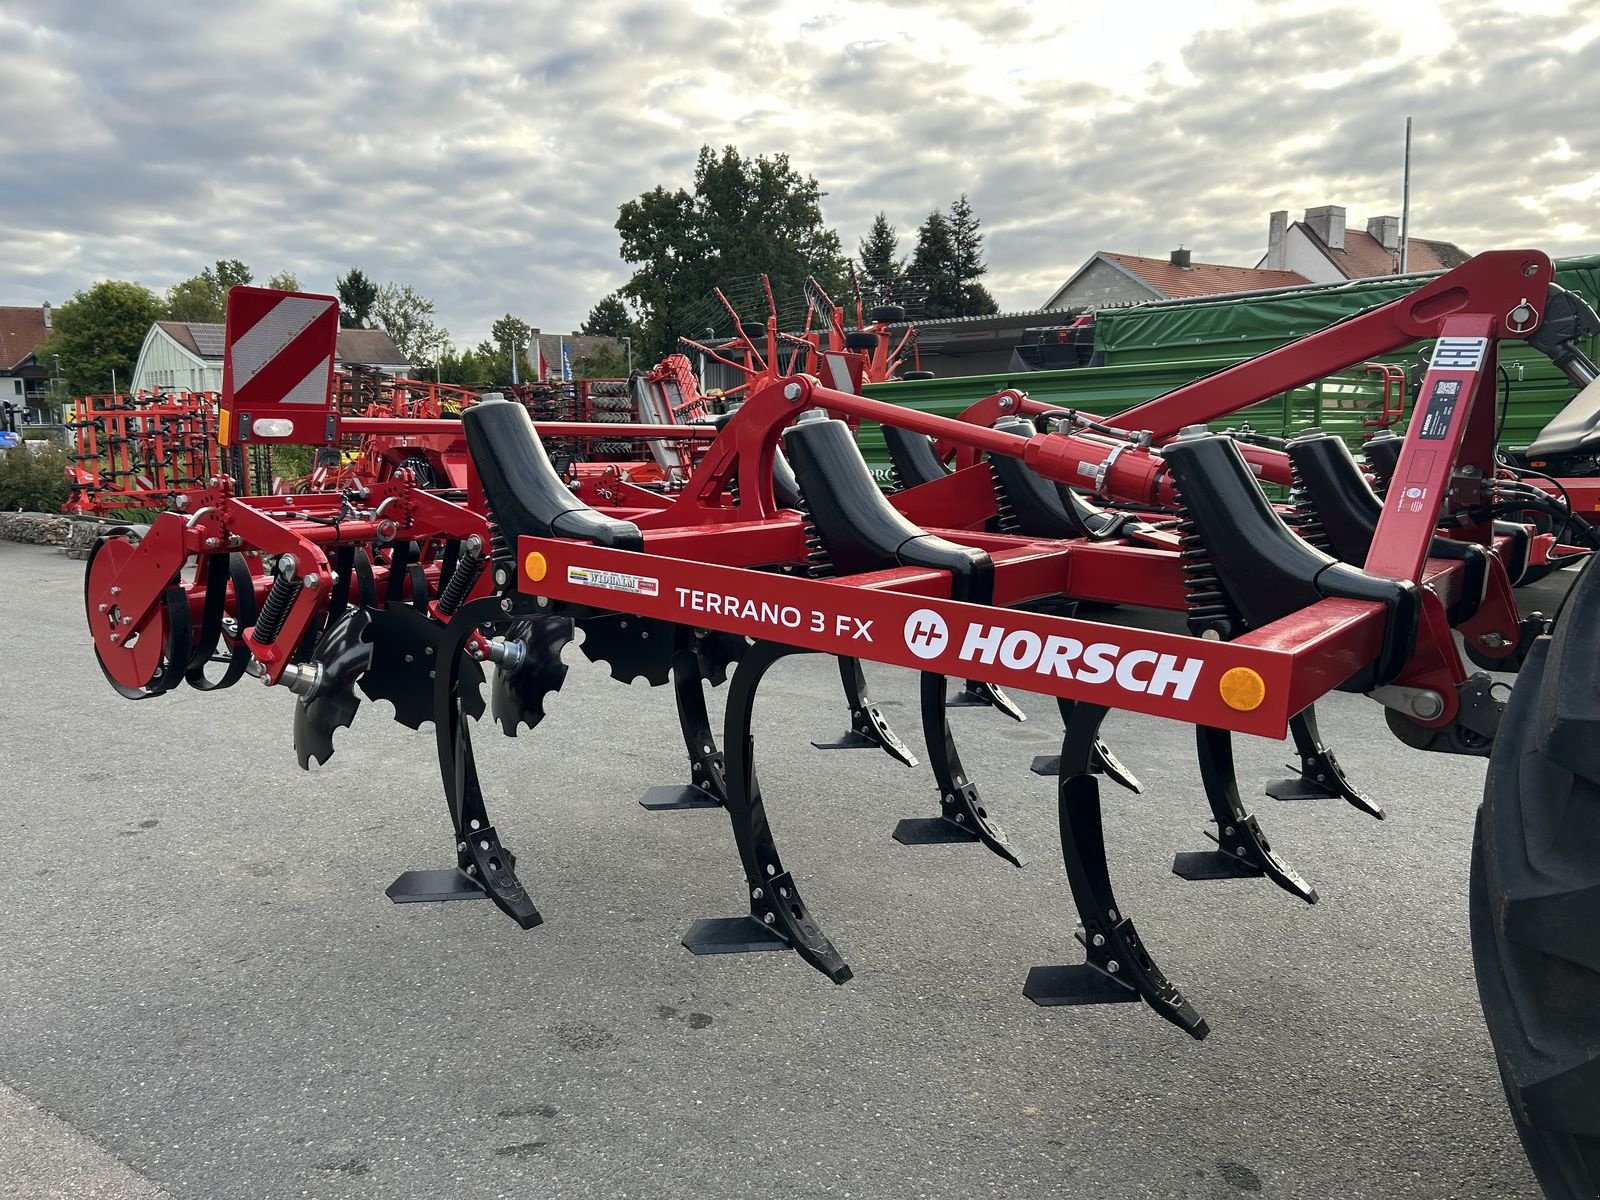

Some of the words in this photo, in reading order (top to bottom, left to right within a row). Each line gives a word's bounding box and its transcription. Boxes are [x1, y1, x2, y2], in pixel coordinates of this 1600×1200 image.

[1432, 339, 1483, 368] EAC
[590, 573, 636, 589] WIDHALM
[675, 587, 801, 628] TERRANO
[810, 610, 825, 633] 3
[835, 614, 874, 643] FX
[958, 622, 1204, 701] HORSCH
